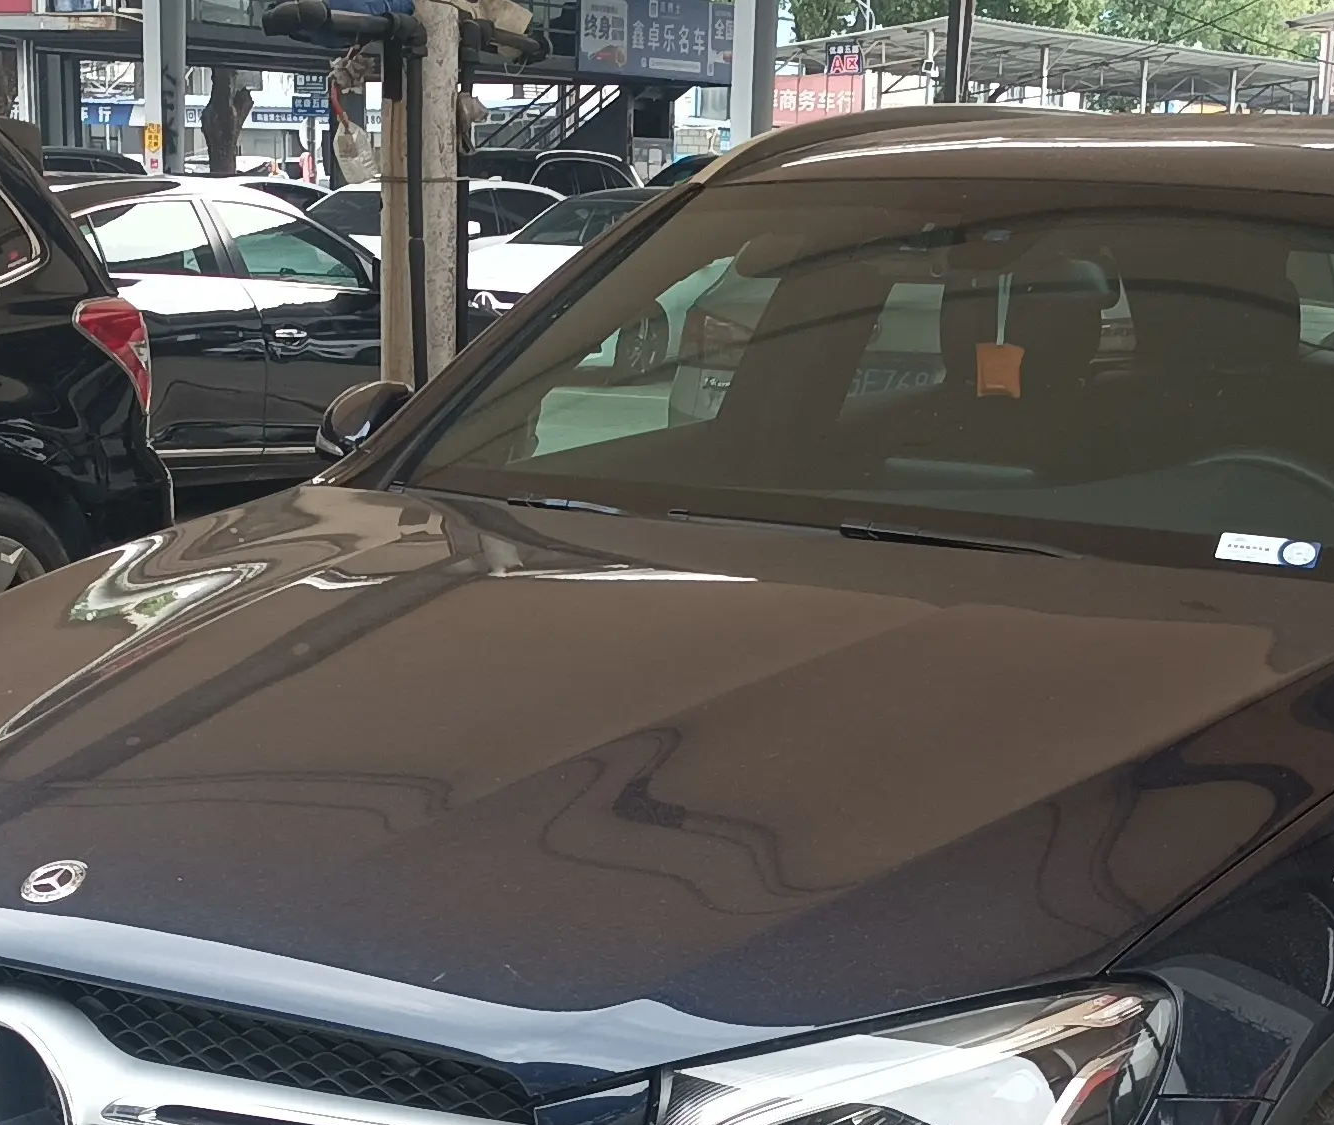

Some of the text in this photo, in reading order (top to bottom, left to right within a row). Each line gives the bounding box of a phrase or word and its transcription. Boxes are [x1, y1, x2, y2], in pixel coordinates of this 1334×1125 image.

[584, 14, 611, 40] 终身
[631, 20, 705, 56] 鑫卓乐名车
[830, 54, 859, 73] A区
